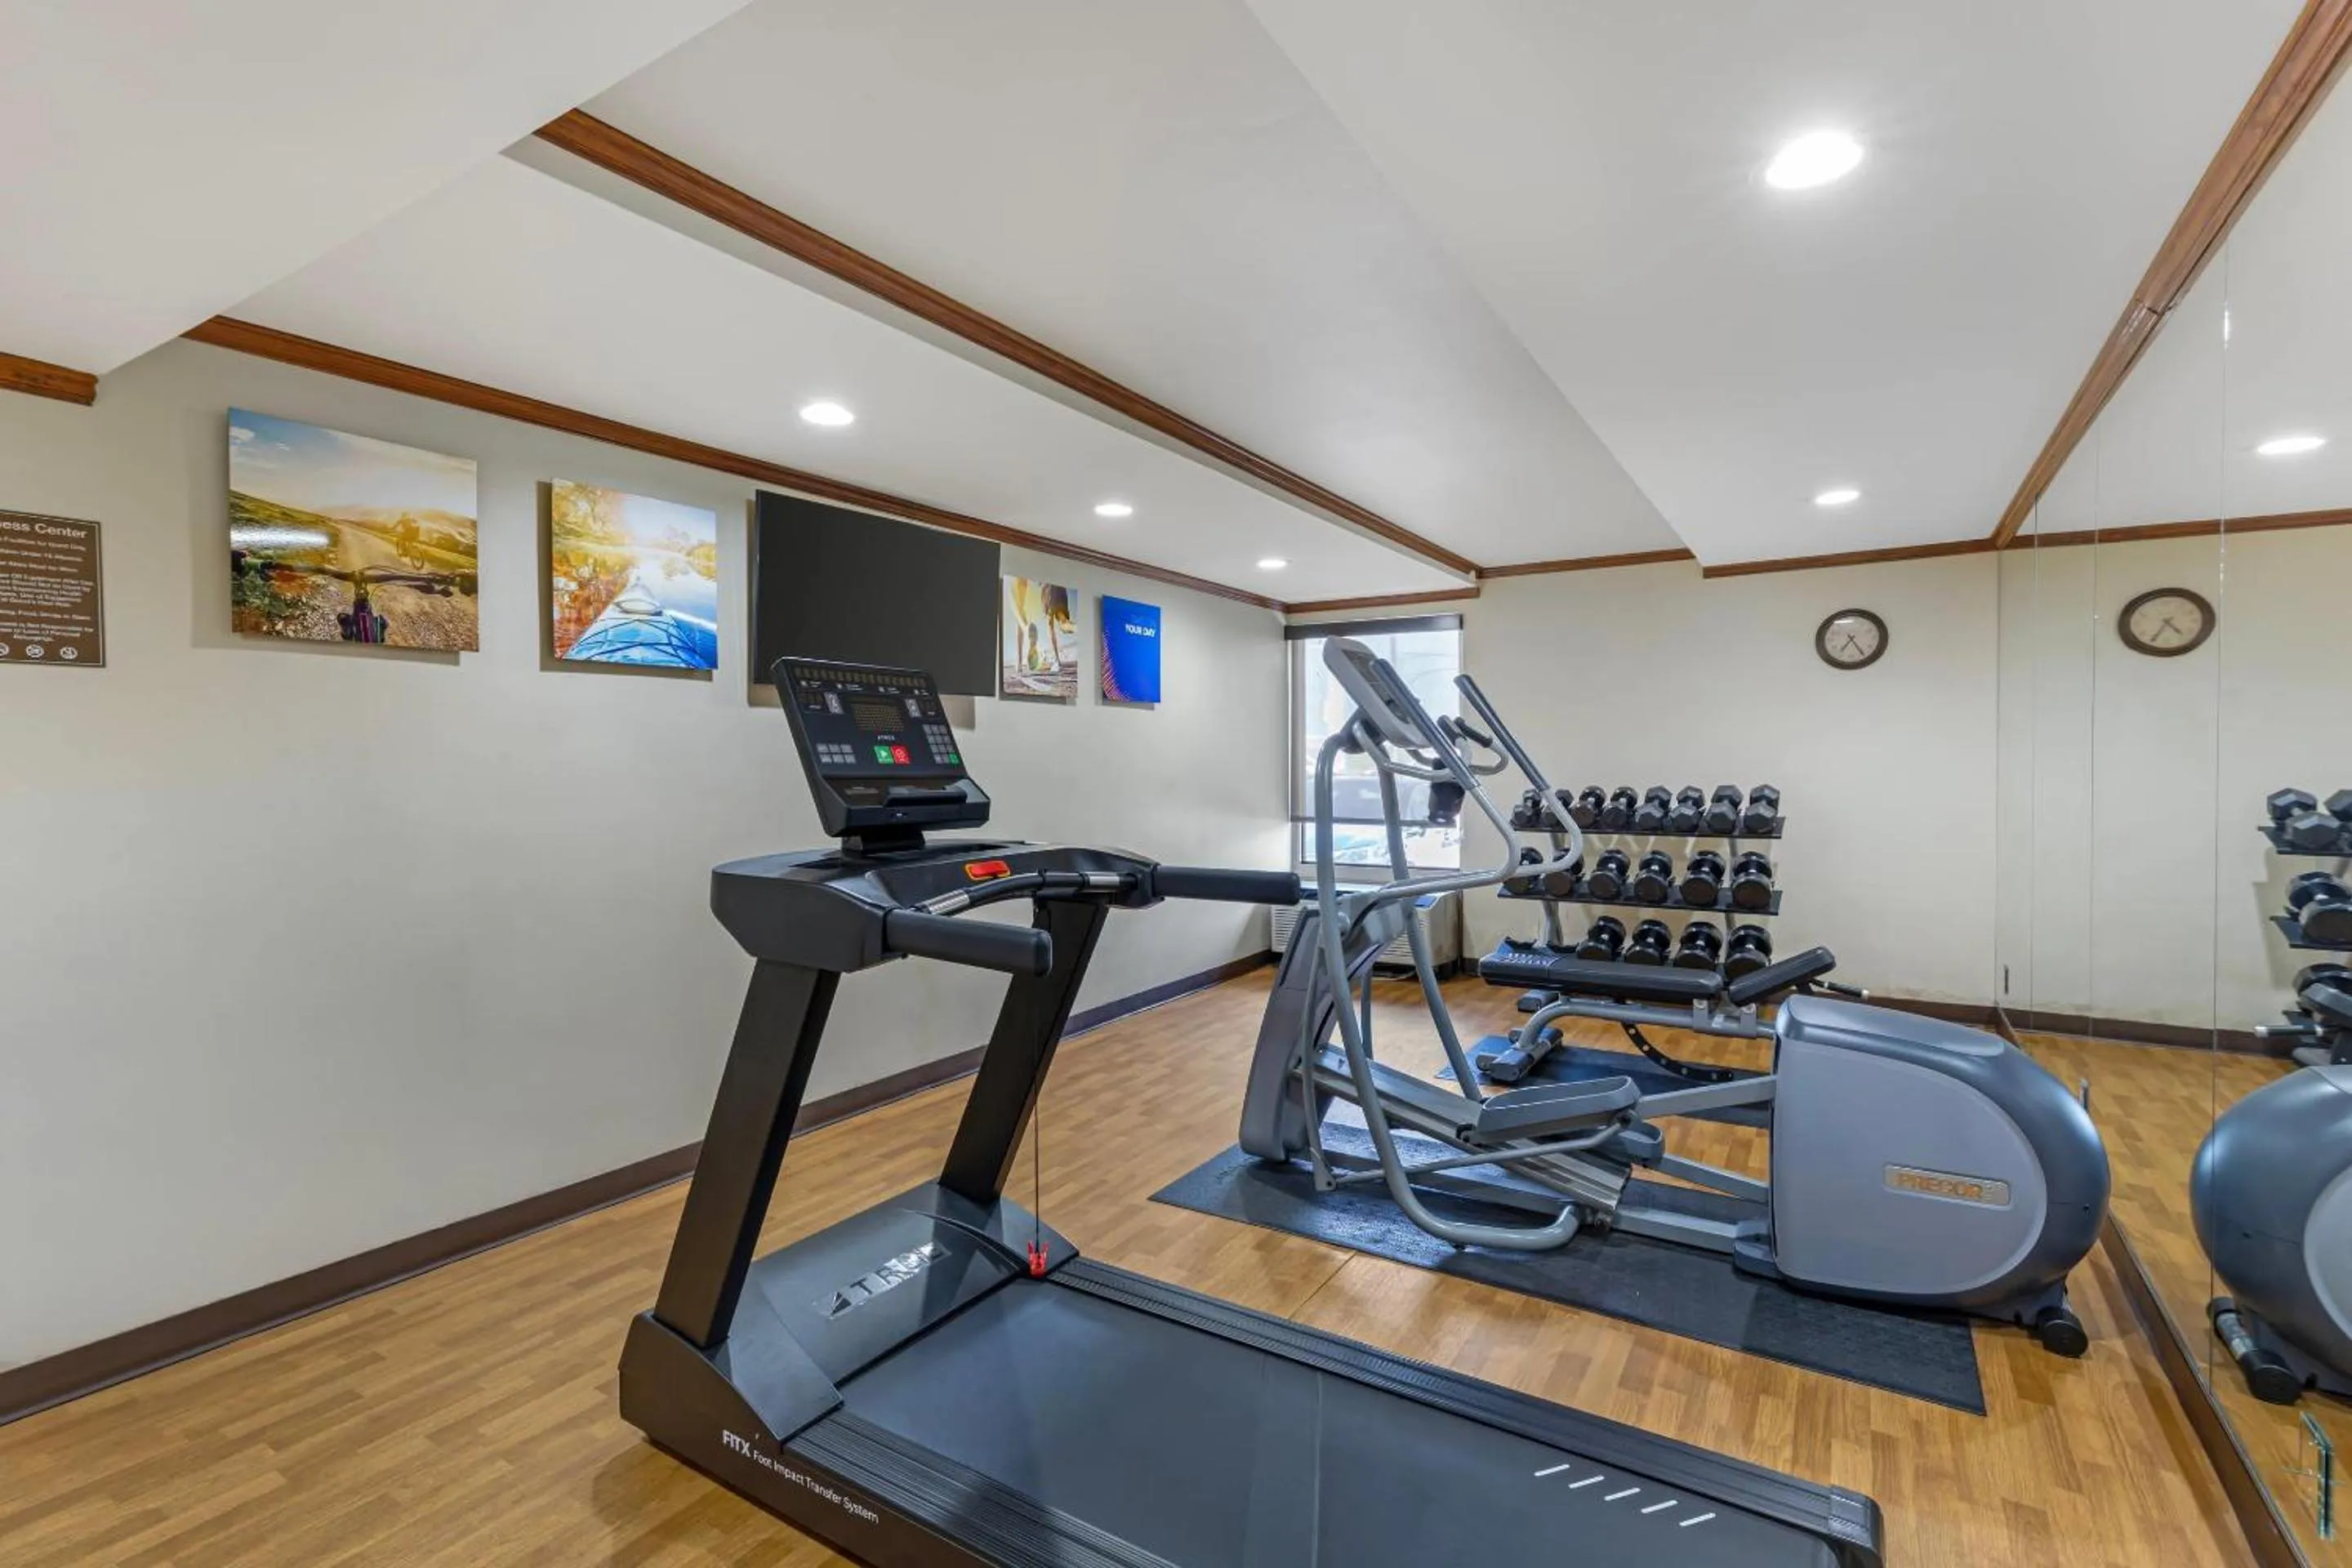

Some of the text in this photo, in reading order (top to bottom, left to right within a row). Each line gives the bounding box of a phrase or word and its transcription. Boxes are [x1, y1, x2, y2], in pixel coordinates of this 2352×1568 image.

[34, 523, 88, 538] Center
[1125, 623, 1142, 635] YOUR
[1898, 1172, 1984, 1199] PRECOR
[722, 1429, 880, 1524] FITX Foot Impact Transfer System
